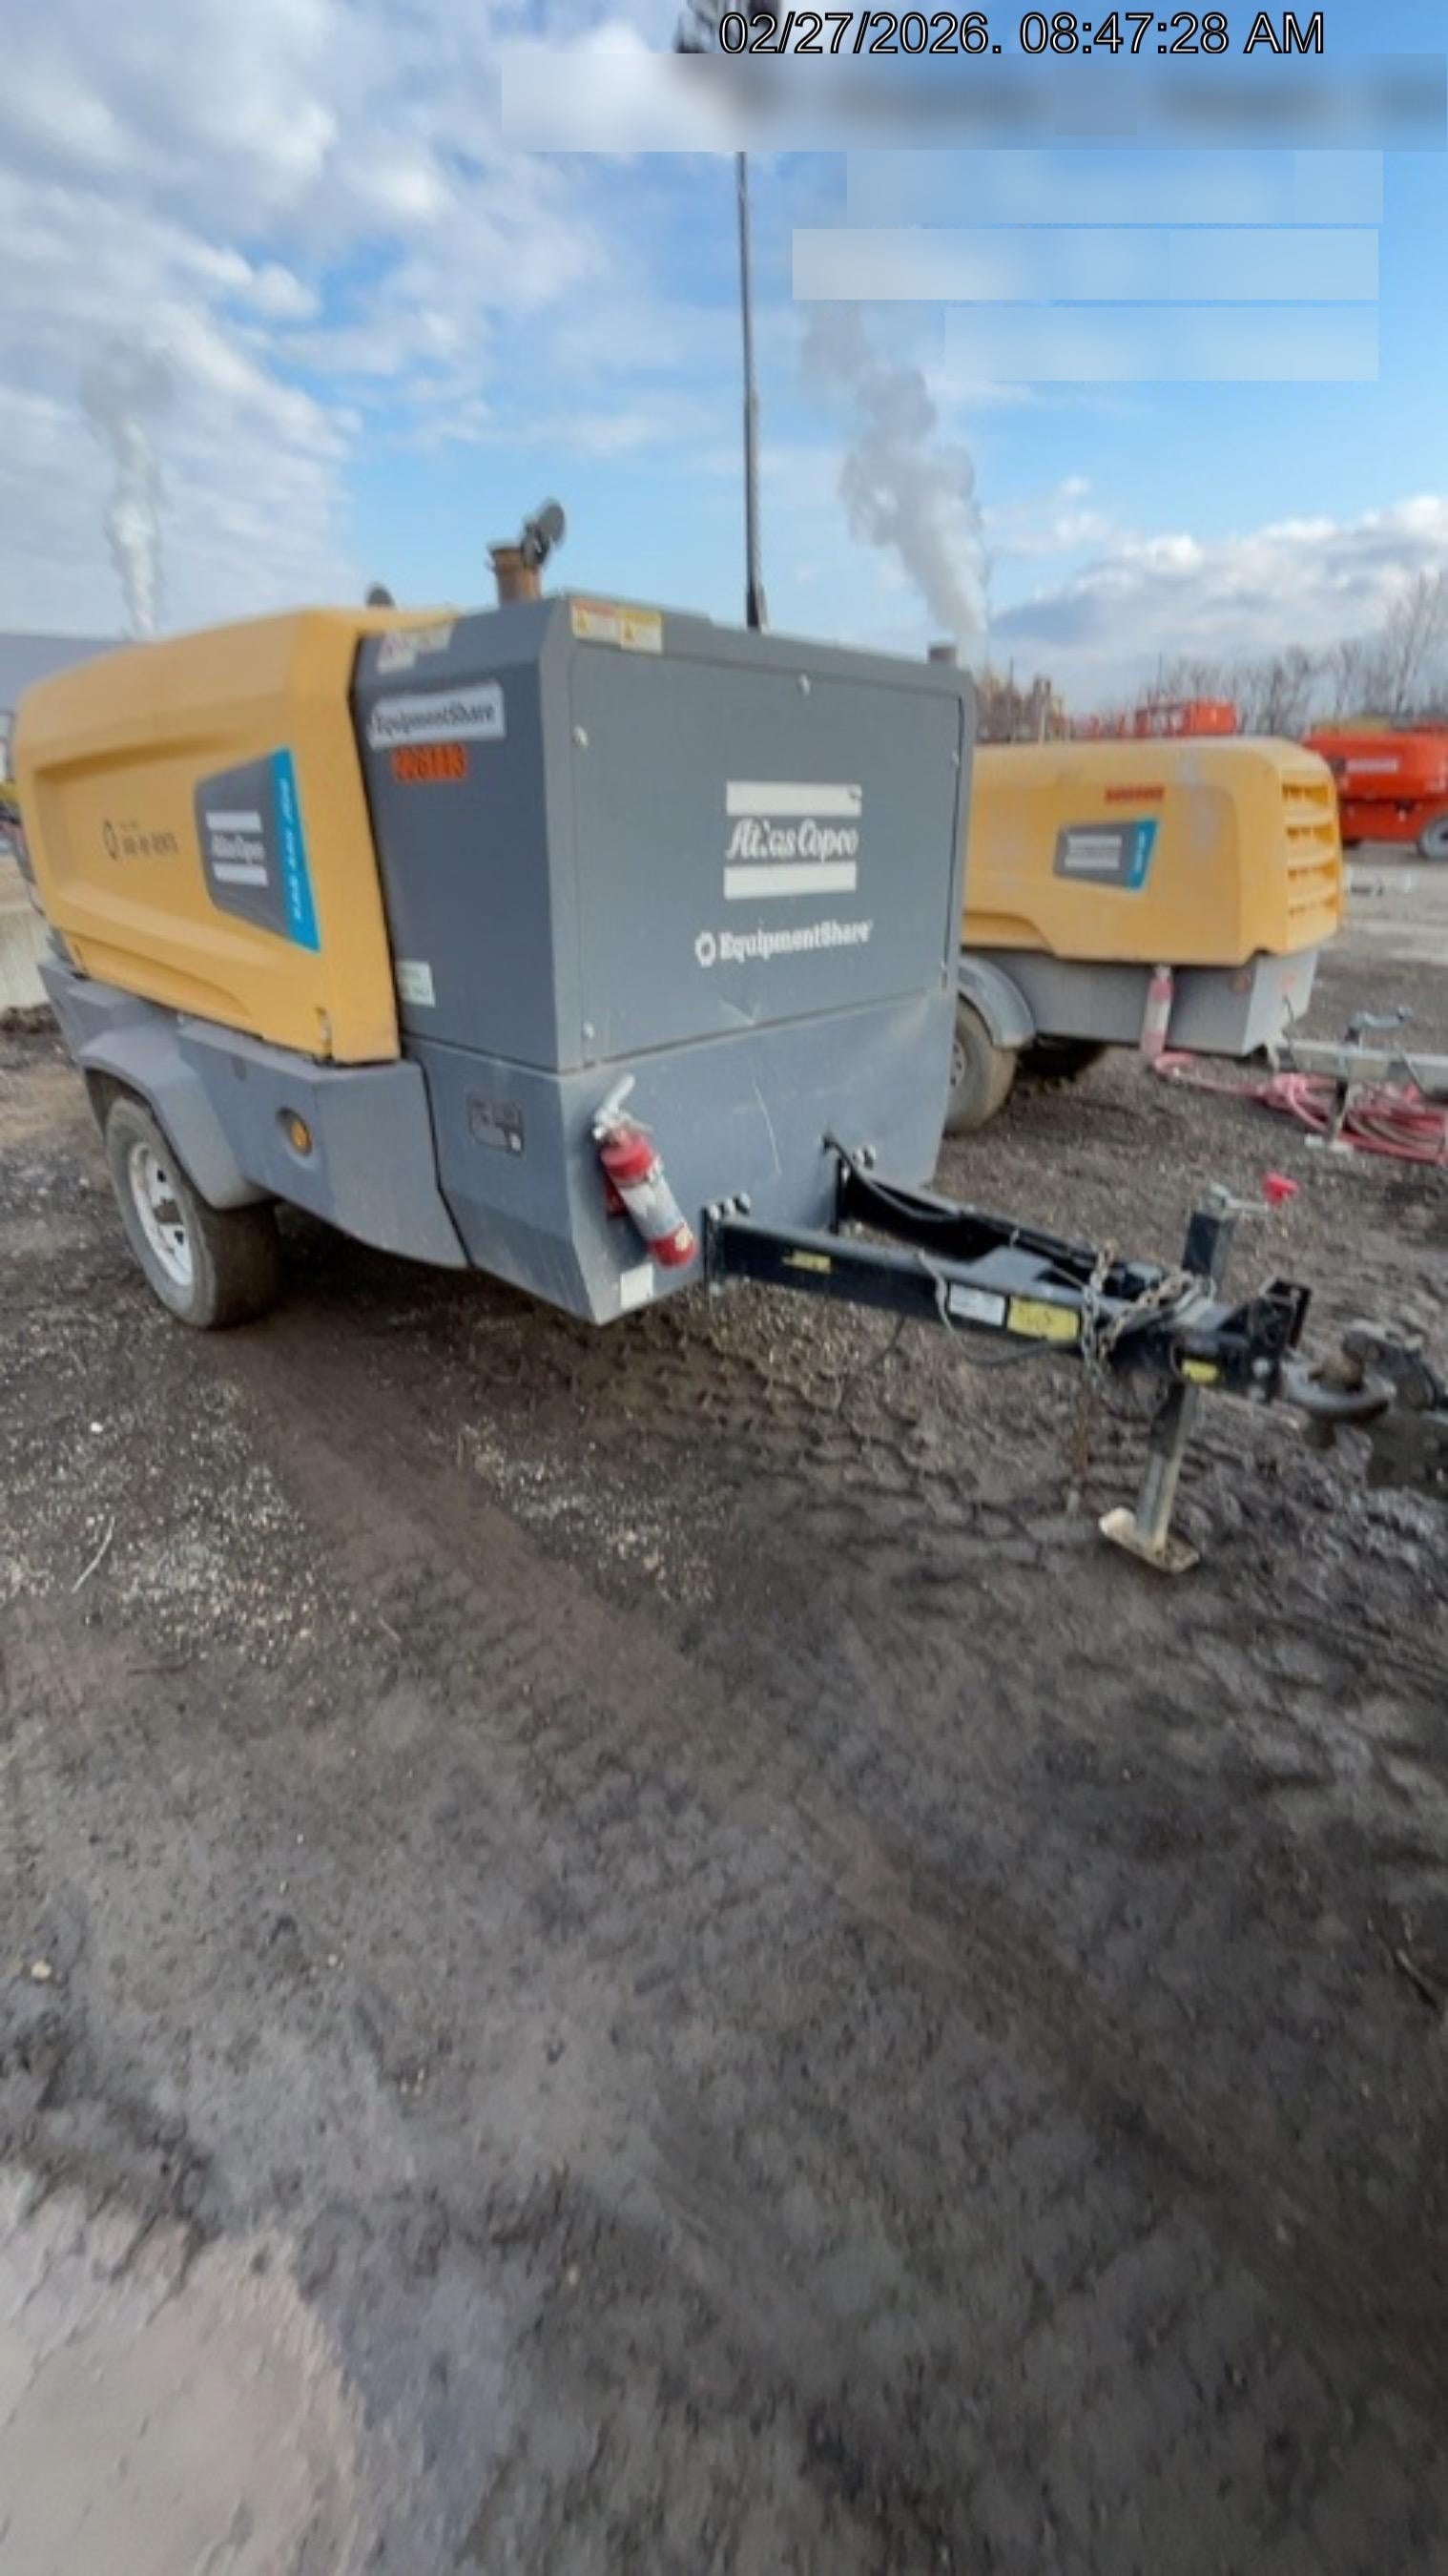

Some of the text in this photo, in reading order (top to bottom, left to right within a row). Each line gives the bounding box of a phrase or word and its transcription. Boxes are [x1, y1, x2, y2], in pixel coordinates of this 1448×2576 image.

[726, 818, 860, 862] Atlas Copco
[719, 919, 871, 963] EquipmentShare
